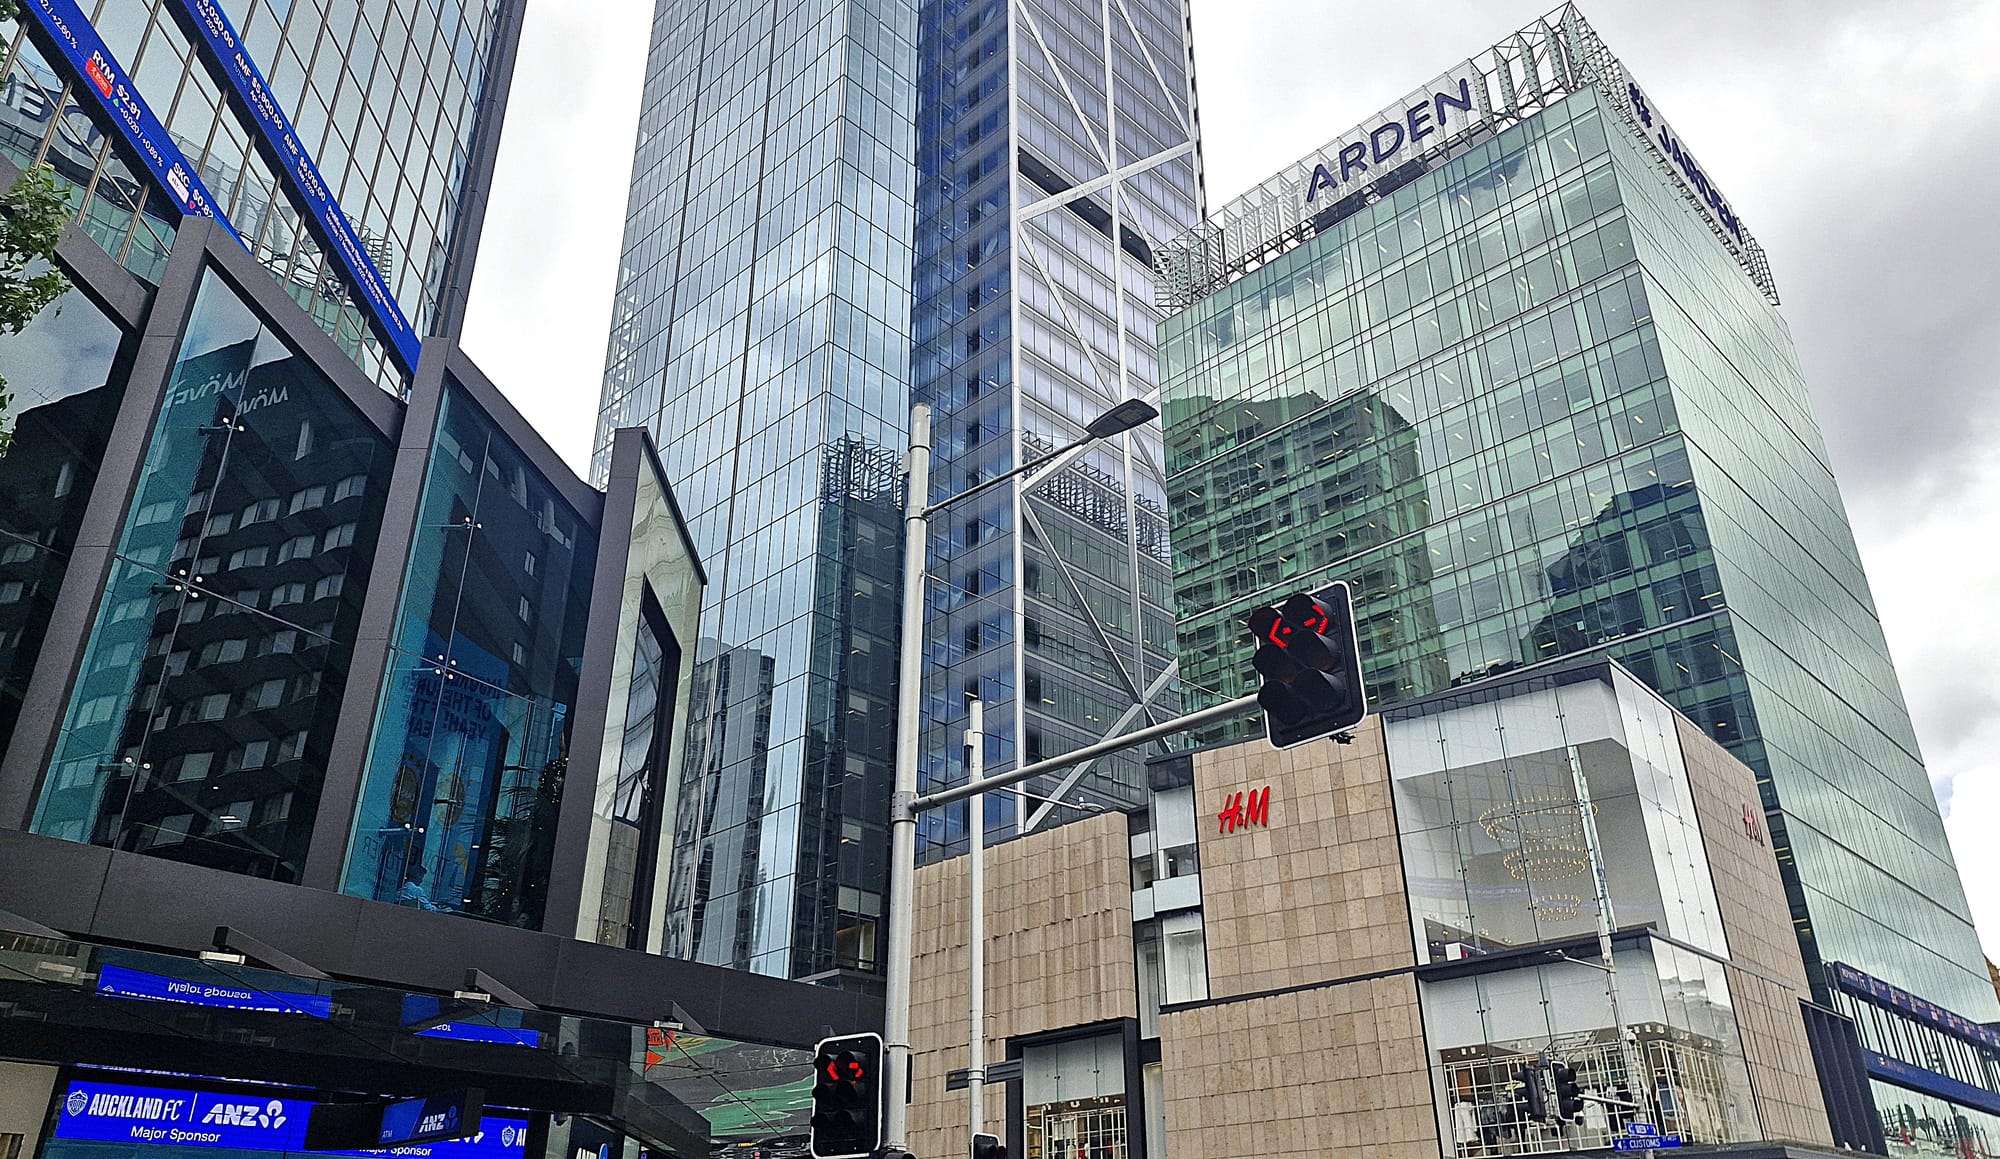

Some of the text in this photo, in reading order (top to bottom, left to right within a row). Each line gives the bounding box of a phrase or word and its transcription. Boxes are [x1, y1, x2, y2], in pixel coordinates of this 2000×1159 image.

[235, 52, 252, 77] AMF
[92, 49, 115, 84] RYM
[117, 84, 141, 120] $2.91
[283, 133, 299, 156] AMF
[1306, 78, 1472, 203] ARDEN
[173, 162, 191, 188] SKC
[1217, 785, 1270, 834] H&M
[88, 1093, 260, 1127] AUCKLAND FC ANZ
[130, 1126, 221, 1143] Major Sponsor
[418, 1113, 446, 1134] ANZ
[1629, 1138, 1661, 1149] CUSTOMS
